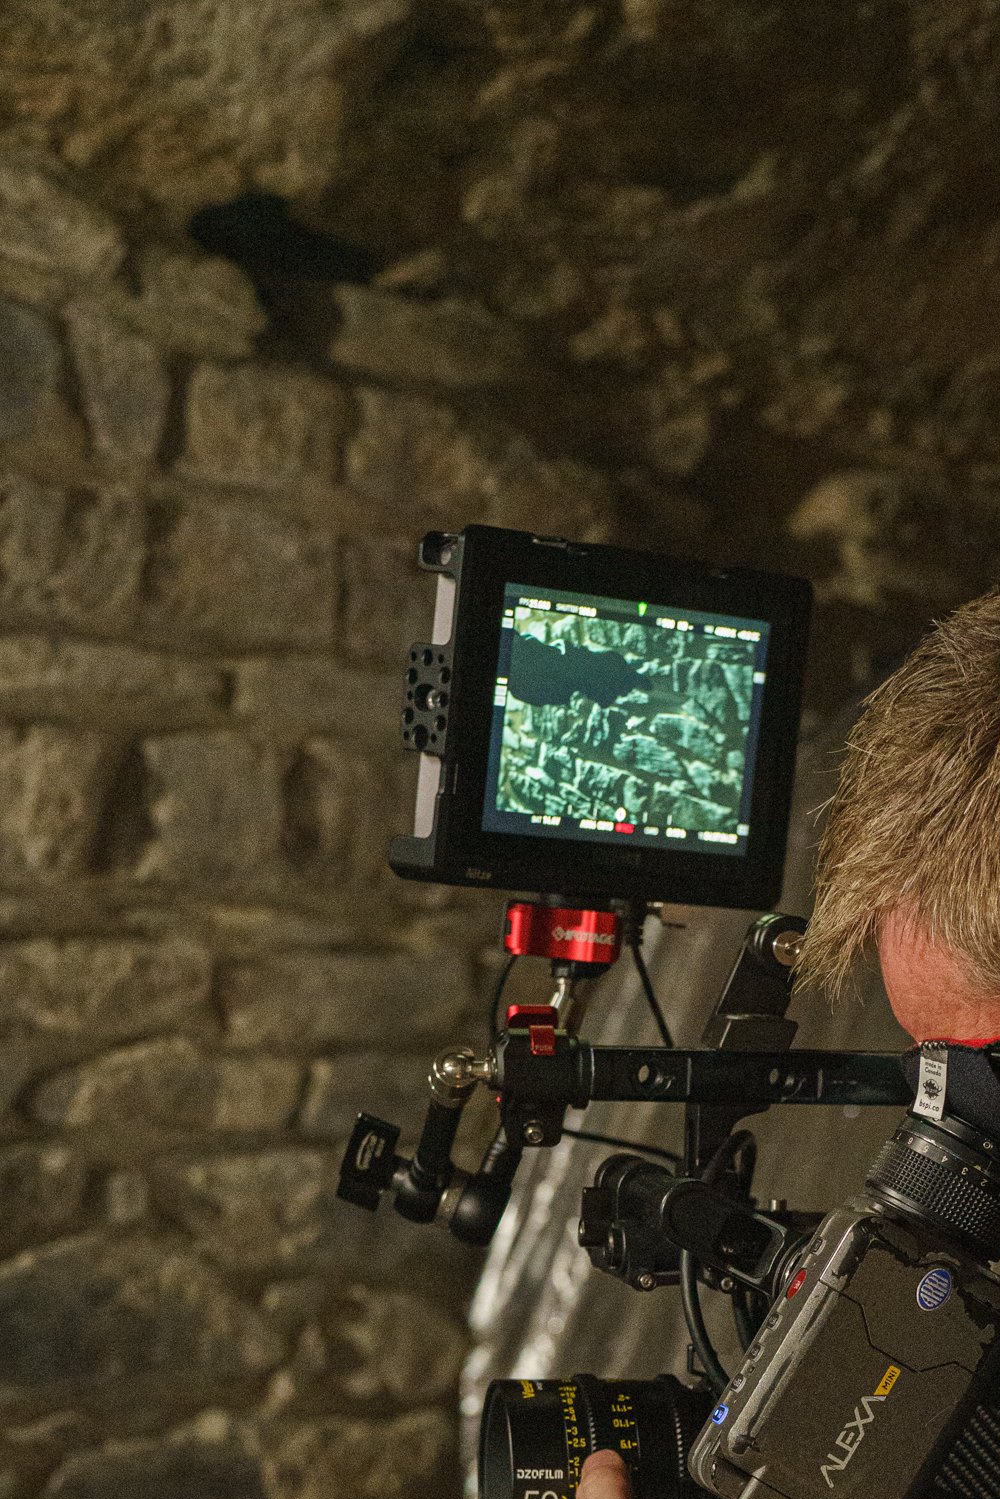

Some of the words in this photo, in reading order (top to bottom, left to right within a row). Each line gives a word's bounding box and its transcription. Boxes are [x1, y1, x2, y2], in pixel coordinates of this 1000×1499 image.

[924, 1066, 942, 1077] Canada
[919, 1272, 950, 1307] ARRI
[881, 1369, 898, 1390] MINI
[820, 1396, 887, 1489] ALEXA
[516, 1468, 564, 1480] DZOFILM
